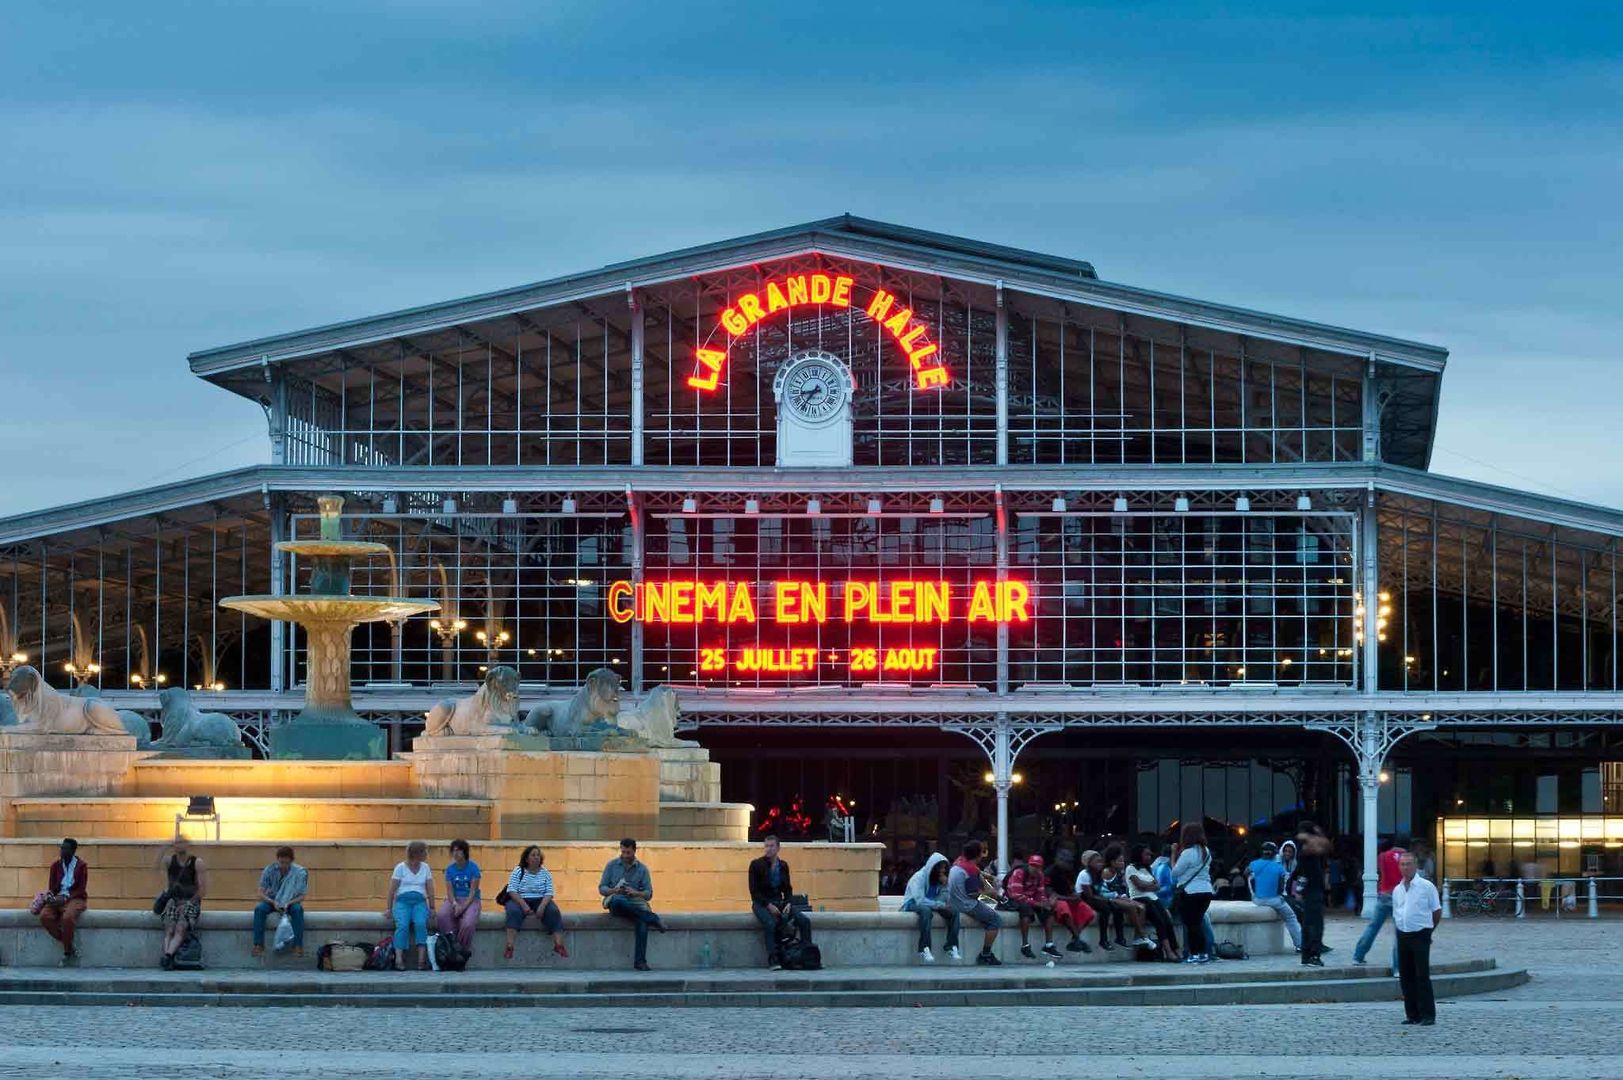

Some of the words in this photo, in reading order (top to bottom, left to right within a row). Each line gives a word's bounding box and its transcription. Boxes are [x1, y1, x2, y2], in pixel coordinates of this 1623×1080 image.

[688, 347, 727, 391] LA
[720, 274, 853, 337] GRANDE
[866, 289, 949, 390] HALLE
[608, 580, 756, 624] CINEMA
[775, 580, 827, 624] EN
[844, 580, 950, 624] PLEIN
[966, 580, 1029, 624] AIR
[700, 648, 725, 671] 25
[735, 647, 818, 671] JUILLET
[850, 648, 877, 670] 26
[883, 648, 938, 671] AOUT
